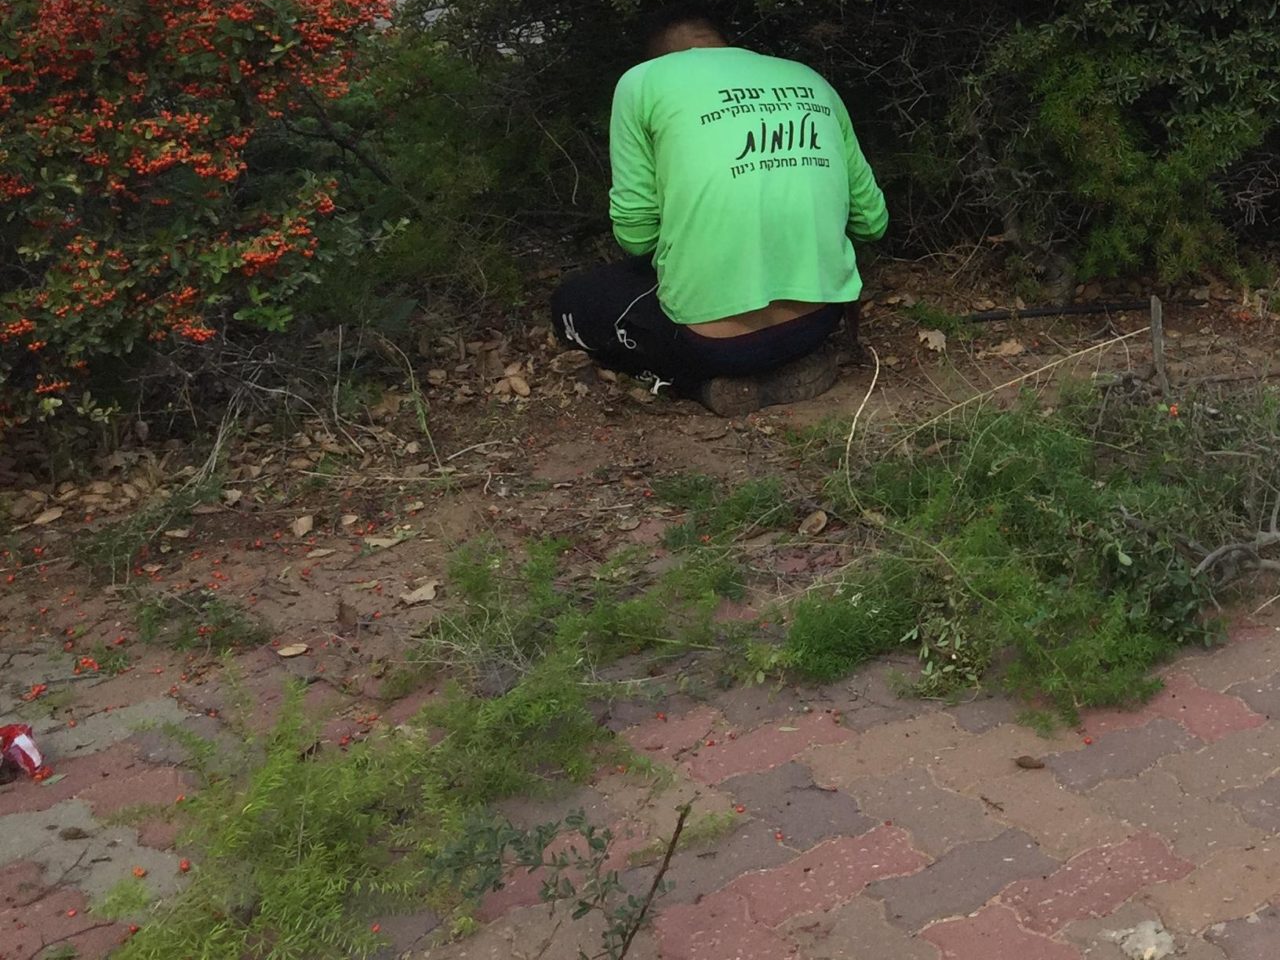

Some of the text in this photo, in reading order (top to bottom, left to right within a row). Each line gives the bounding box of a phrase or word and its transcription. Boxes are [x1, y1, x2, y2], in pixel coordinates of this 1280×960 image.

[718, 86, 815, 103] זכרון יעקב
[700, 101, 831, 125] מושבה ירוקה ומקיימת
[730, 161, 755, 179] גינון
[759, 157, 798, 171] מחלקת
